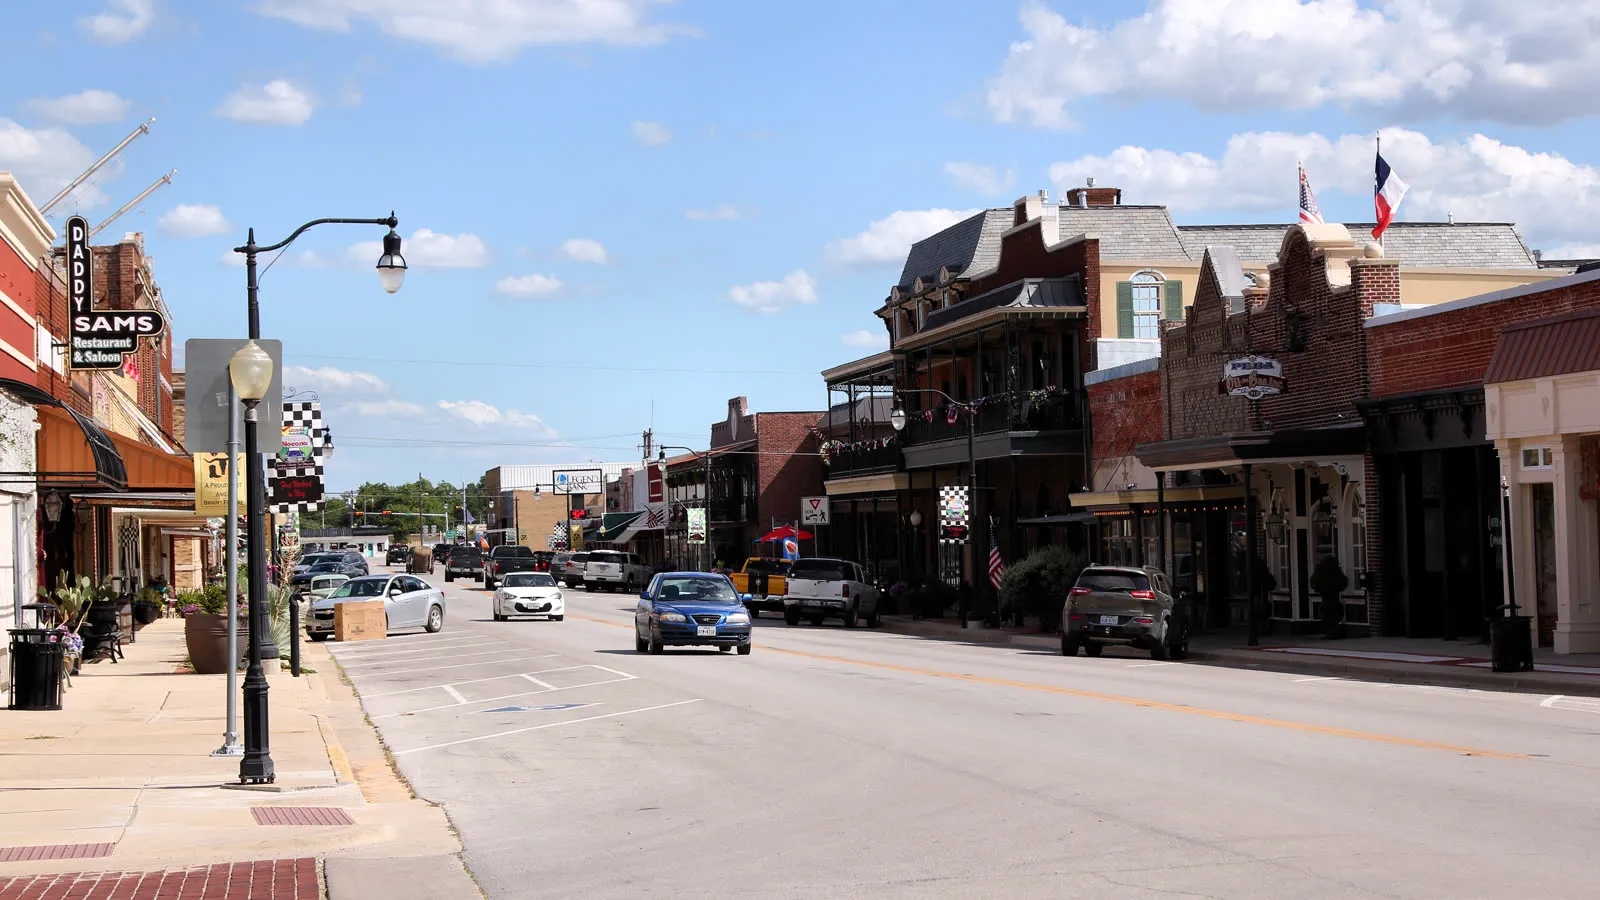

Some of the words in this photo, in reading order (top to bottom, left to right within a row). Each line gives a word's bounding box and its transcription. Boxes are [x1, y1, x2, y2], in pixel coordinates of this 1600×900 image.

[73, 226, 85, 312] DADDY
[75, 316, 153, 332] SAMS
[73, 336, 132, 348] Restaurant
[73, 351, 83, 363] &
[84, 350, 121, 363] Saloon
[567, 475, 599, 483] LEGEND
